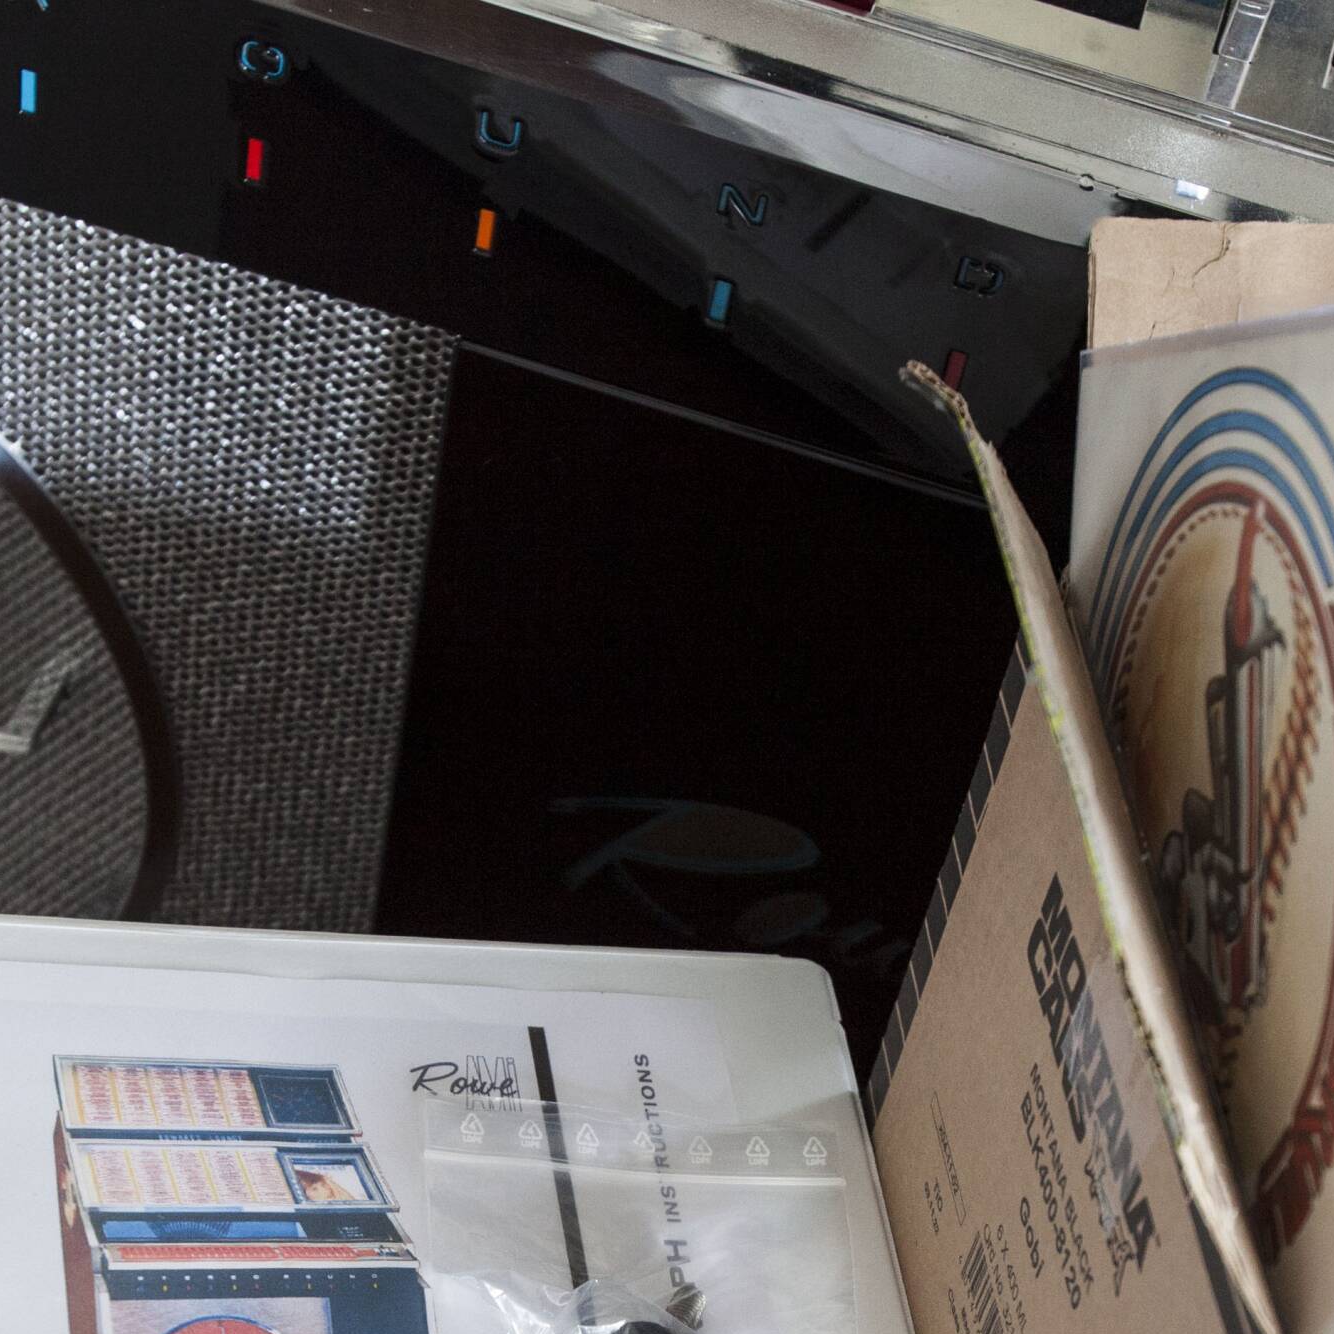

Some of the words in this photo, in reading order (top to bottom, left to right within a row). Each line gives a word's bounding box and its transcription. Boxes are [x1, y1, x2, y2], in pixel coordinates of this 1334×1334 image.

[634, 1053, 682, 1223] INSRUCTIONS
[1027, 917, 1087, 1145] CANS
[1041, 871, 1159, 1275] MONTANA
[1020, 1196, 1046, 1279] Gobi
[1030, 1062, 1068, 1200] MONTANA
[1065, 1196, 1095, 1296] BLACK
